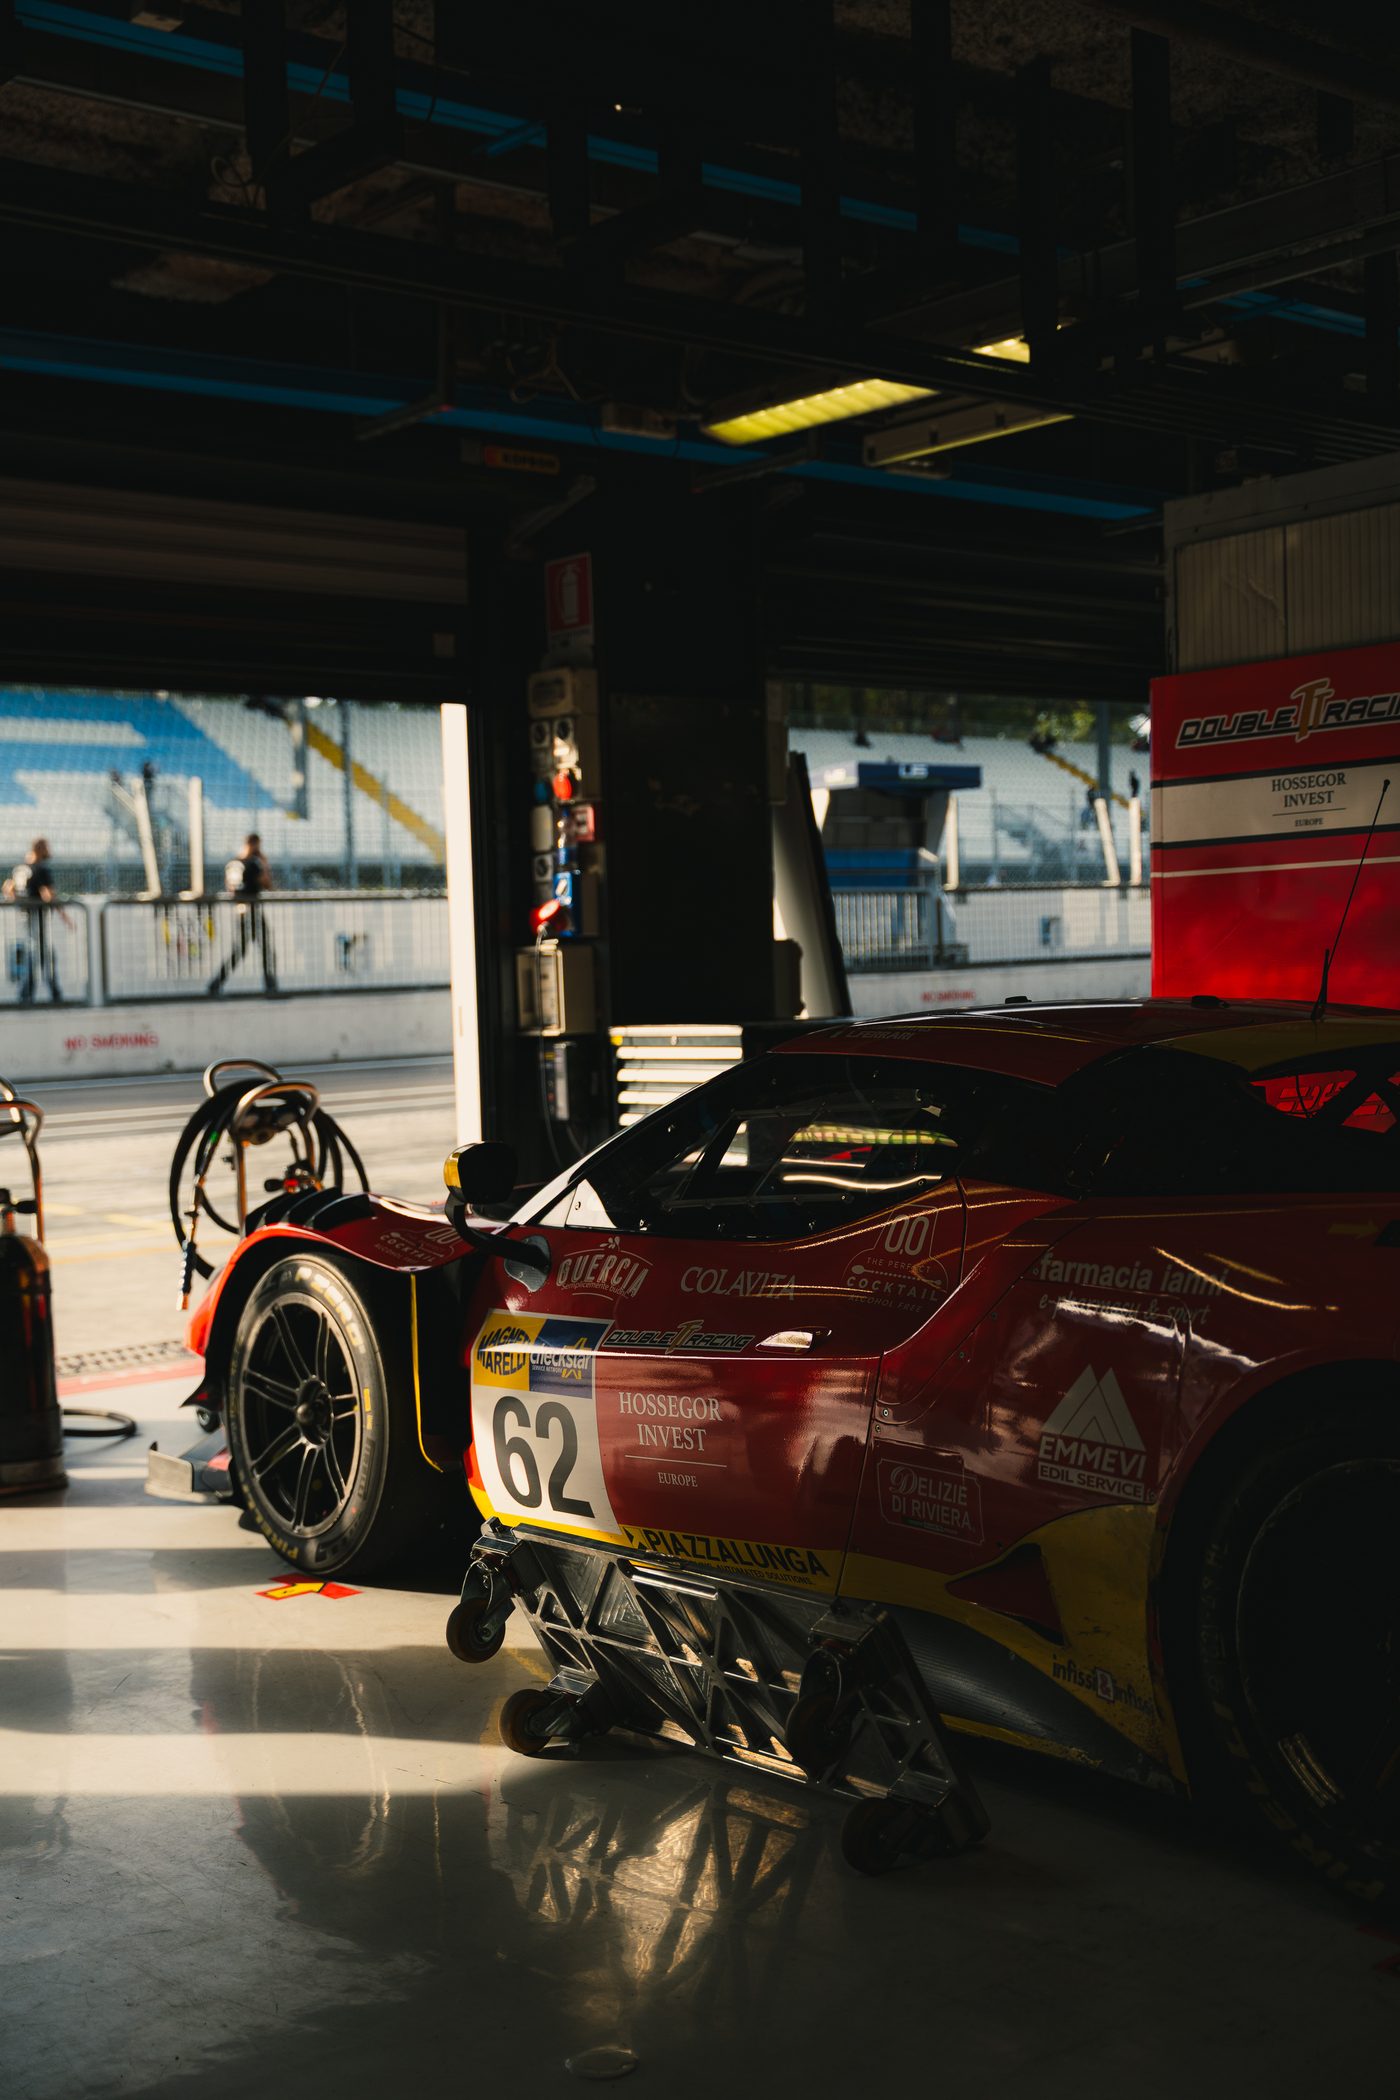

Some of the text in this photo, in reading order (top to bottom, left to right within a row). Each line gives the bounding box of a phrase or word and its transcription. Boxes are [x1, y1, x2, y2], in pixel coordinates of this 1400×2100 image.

[1177, 705, 1299, 748] DOUBLE
[1271, 772, 1347, 792] HOSSEGOR
[1283, 789, 1335, 808] INVEST
[1294, 817, 1324, 828] EUROPE
[866, 1256, 883, 1267] THE
[1039, 1251, 1153, 1291] farmacia
[680, 1265, 798, 1301] COLAVITA
[846, 1276, 939, 1302] COCKTAIL
[603, 1330, 678, 1347] DOUBLE
[684, 1333, 753, 1350] RACING
[618, 1391, 723, 1422] HOSSEGOR
[637, 1423, 707, 1452] INVEST
[492, 1396, 596, 1519] 62
[1038, 1434, 1147, 1480] EMMEVI
[657, 1471, 698, 1488] EUROPE
[888, 1465, 968, 1508] DELIZIE
[1039, 1465, 1144, 1499] EDIL SERVICE
[891, 1494, 907, 1515] DI
[911, 1499, 973, 1531] RIVIERA
[643, 1528, 831, 1578] PIAZZALUNGA
